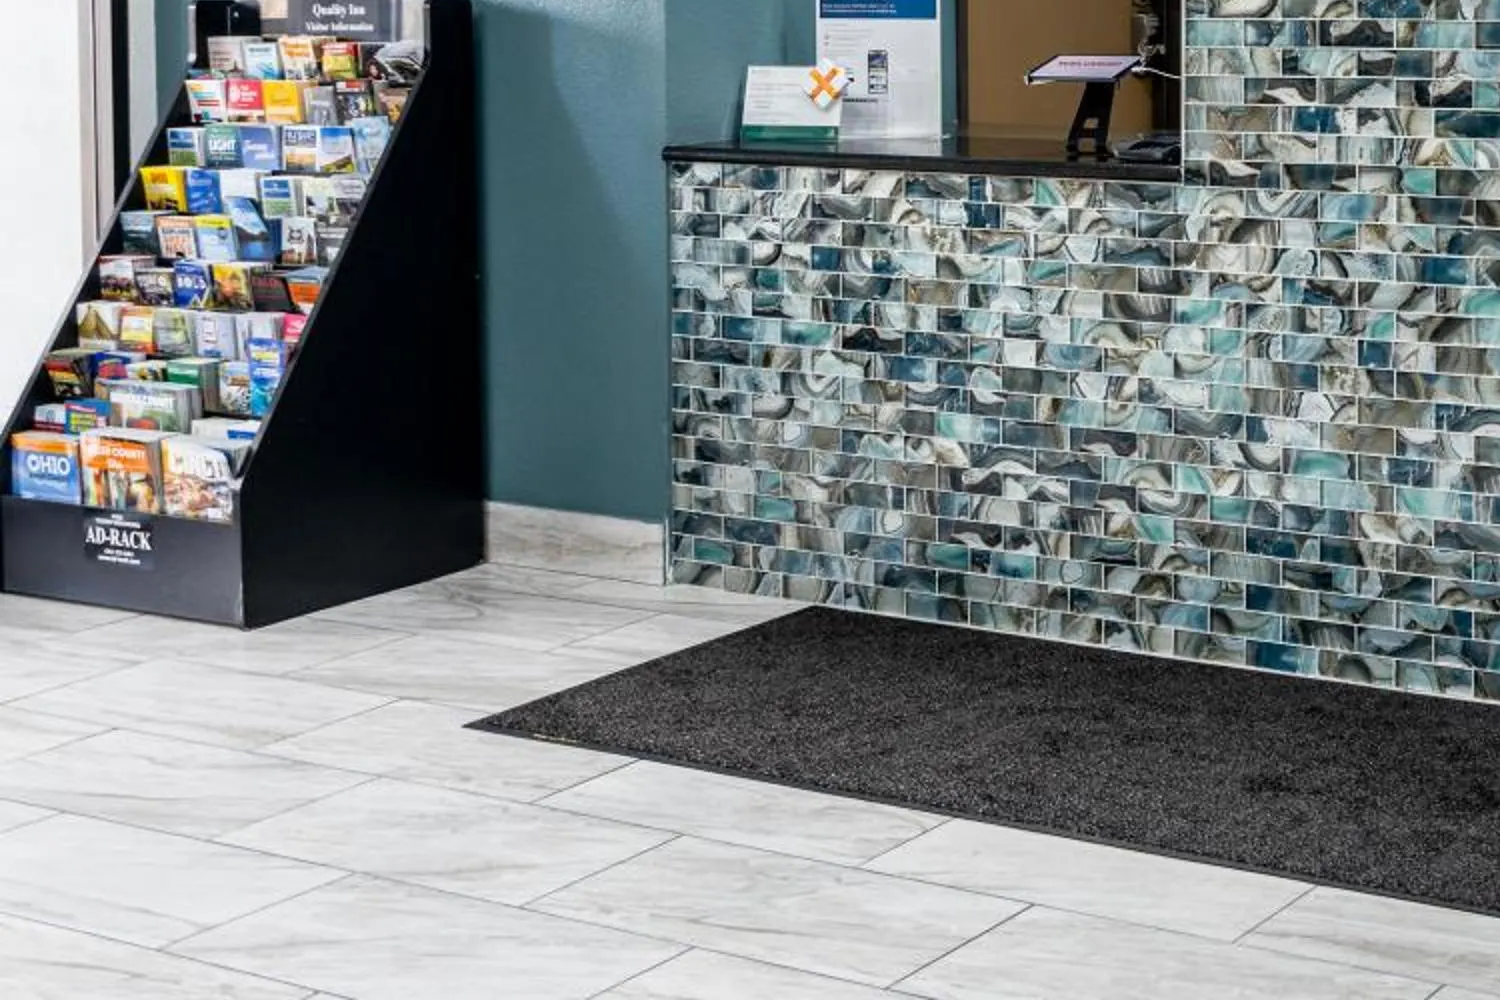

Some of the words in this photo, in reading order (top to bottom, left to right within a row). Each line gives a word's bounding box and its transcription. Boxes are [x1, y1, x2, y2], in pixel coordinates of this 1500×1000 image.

[312, 3, 347, 19] Quality
[349, 3, 366, 16] Inn
[26, 453, 71, 477] OHIO
[85, 525, 152, 551] AD-RACK
